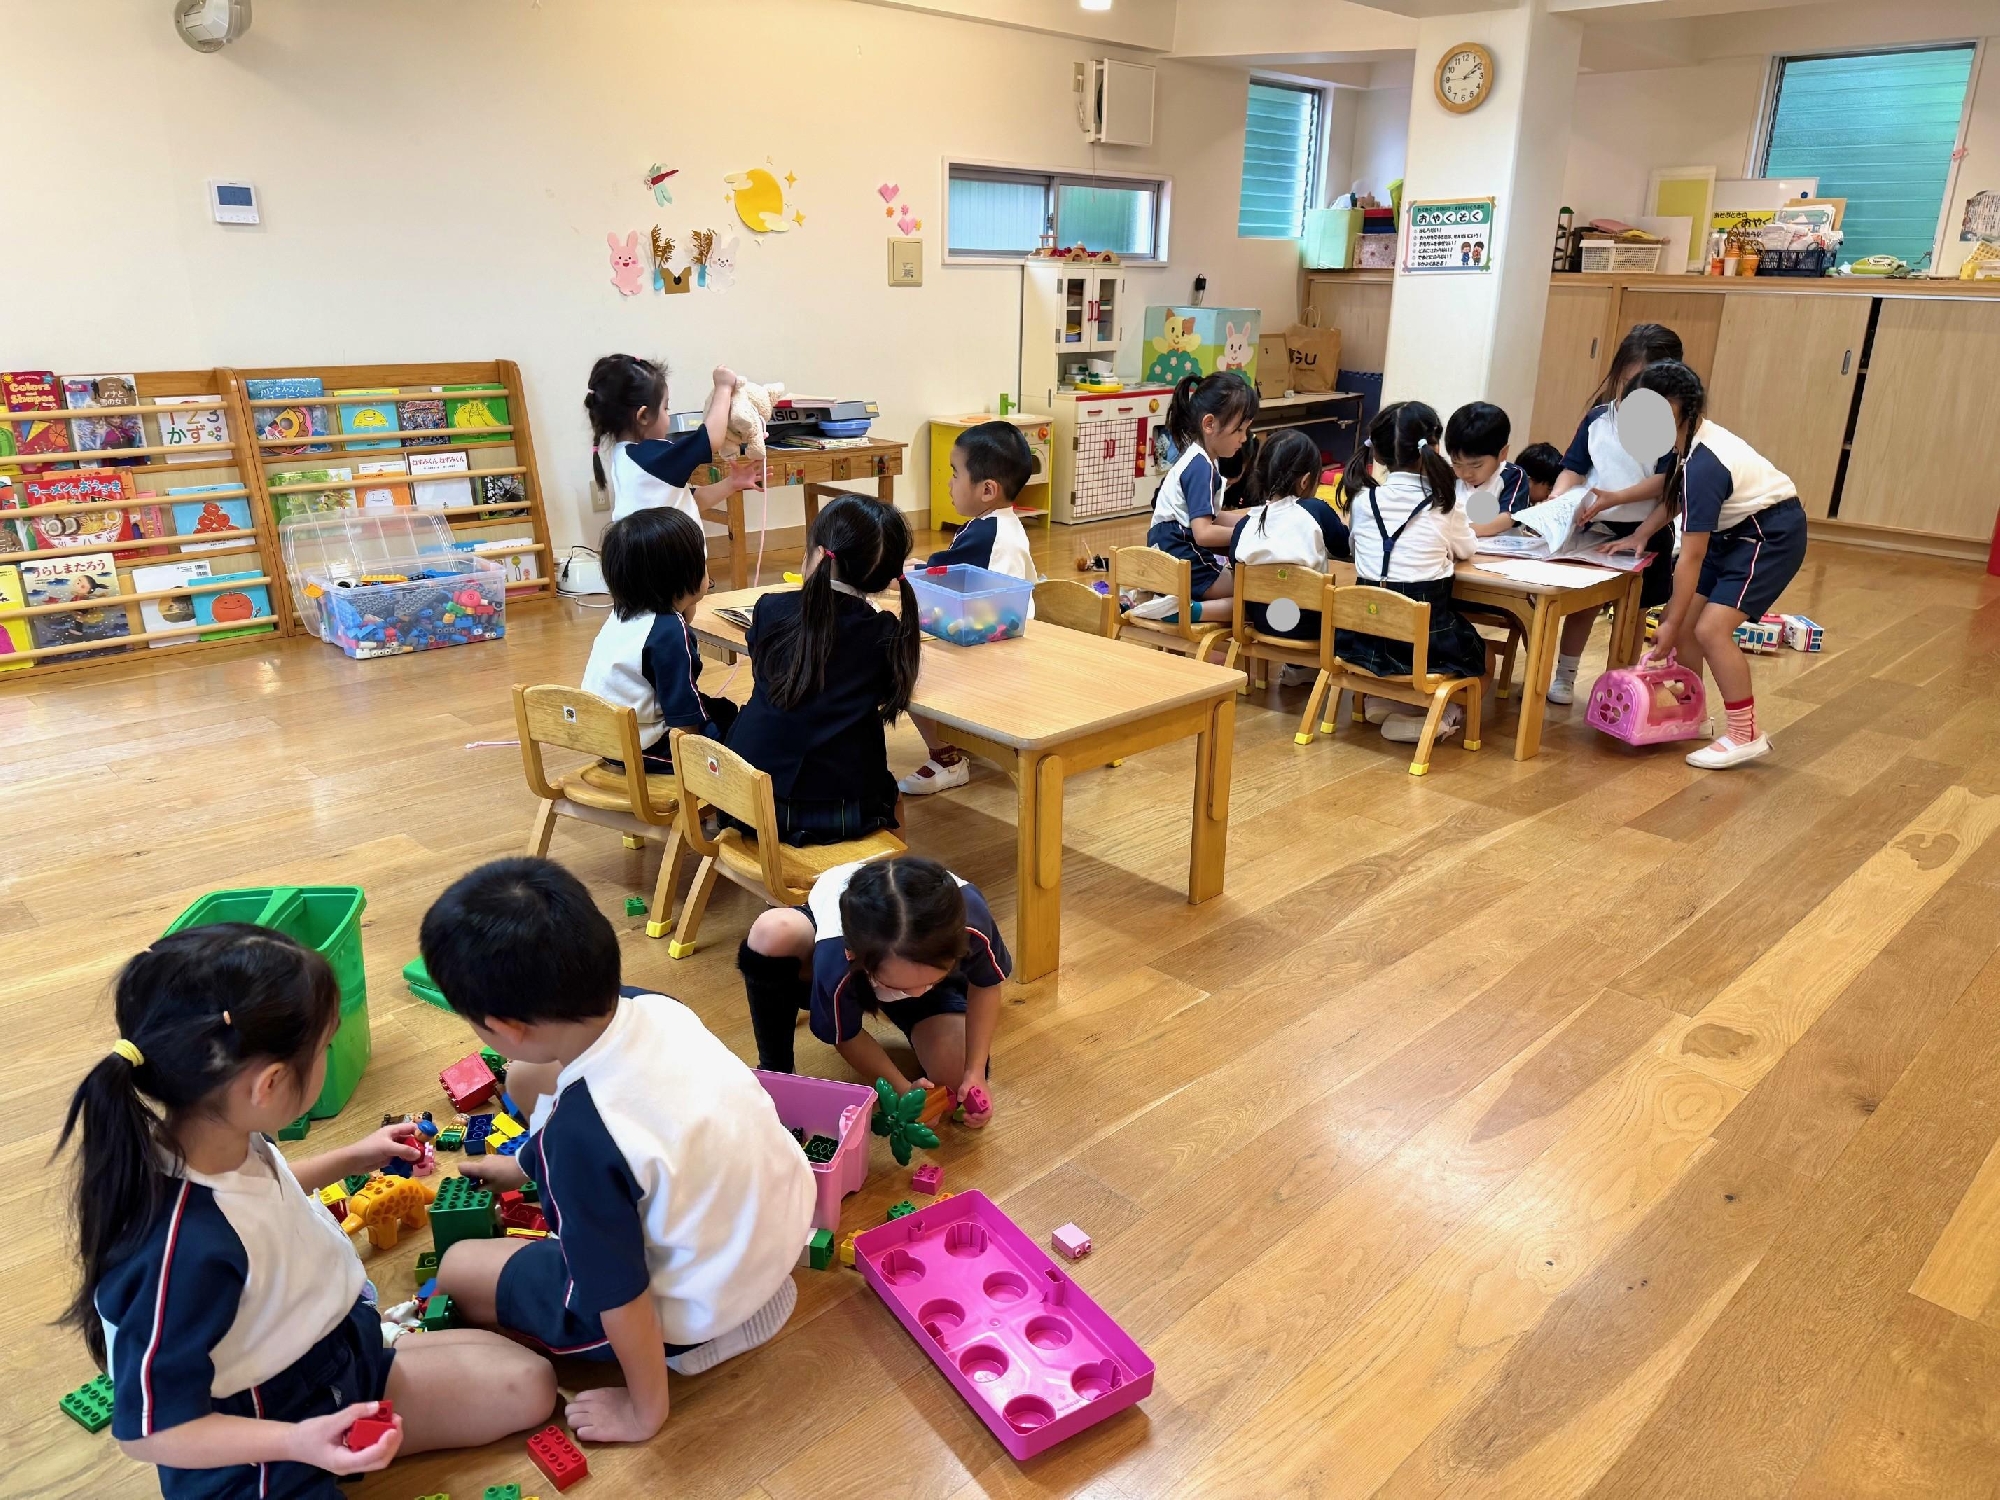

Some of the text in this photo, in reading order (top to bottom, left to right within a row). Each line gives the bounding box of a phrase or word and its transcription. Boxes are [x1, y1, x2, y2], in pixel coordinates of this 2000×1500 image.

[1477, 62, 1482, 70] 2
[1418, 211, 1480, 224] おやくそく
[1741, 214, 1776, 228] おやく
[1289, 348, 1317, 365] GU
[9, 382, 51, 392] Colors
[11, 394, 56, 405] Shapes
[206, 409, 220, 422] 3
[771, 410, 799, 422] SIO
[167, 425, 206, 445] かず
[28, 480, 122, 497] ラーメンのおうさま
[33, 560, 107, 578] うらしまたろう
